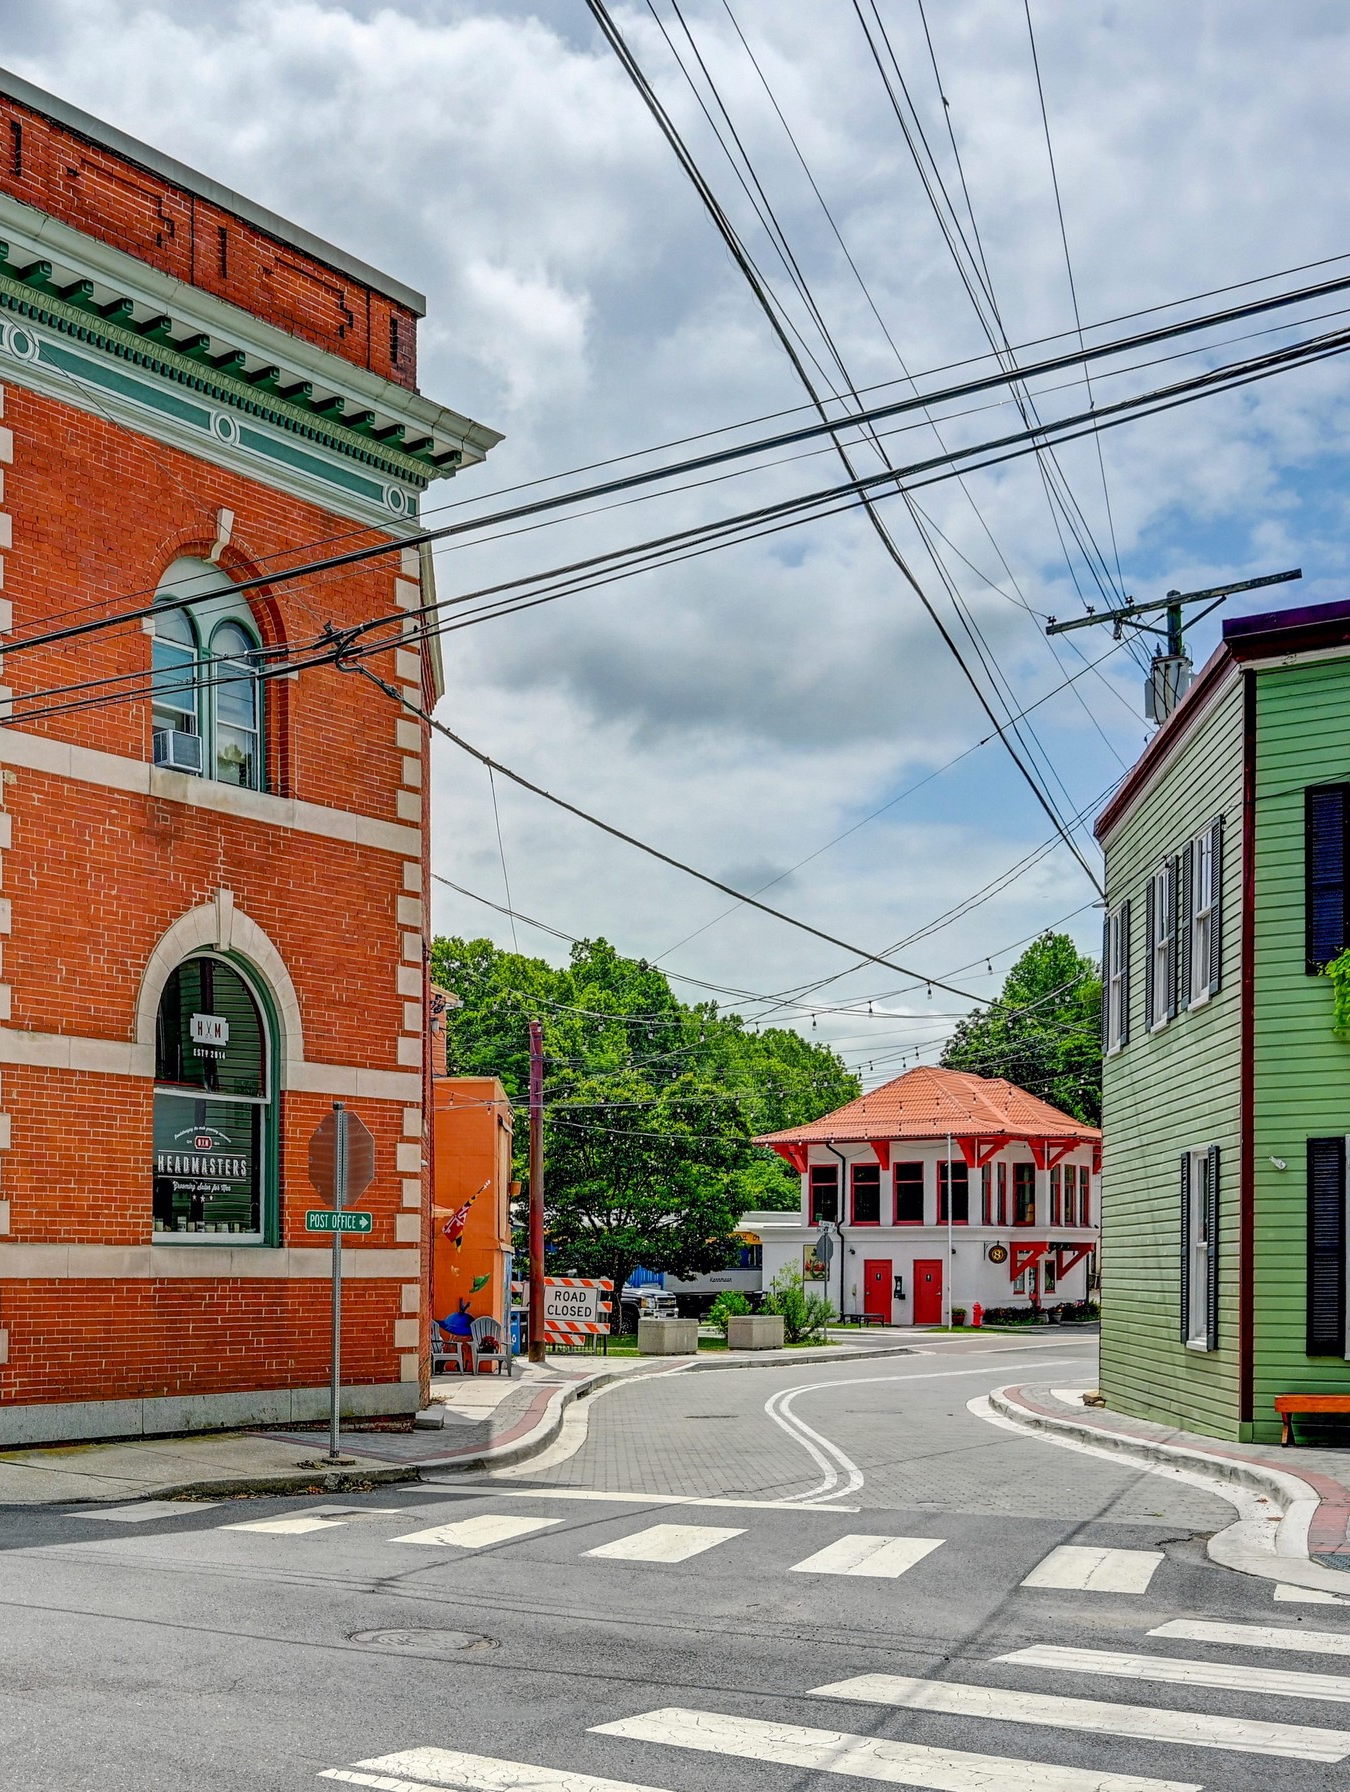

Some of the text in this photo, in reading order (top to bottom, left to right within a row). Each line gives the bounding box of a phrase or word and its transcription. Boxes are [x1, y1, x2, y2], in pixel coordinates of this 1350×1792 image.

[197, 1020, 221, 1038] H M
[210, 1050, 226, 1060] 2014
[157, 1154, 247, 1177] HEADMASTERS
[310, 1213, 356, 1229] POST OFFICE
[554, 1290, 587, 1303] ROAD
[547, 1304, 592, 1318] CLOSED
